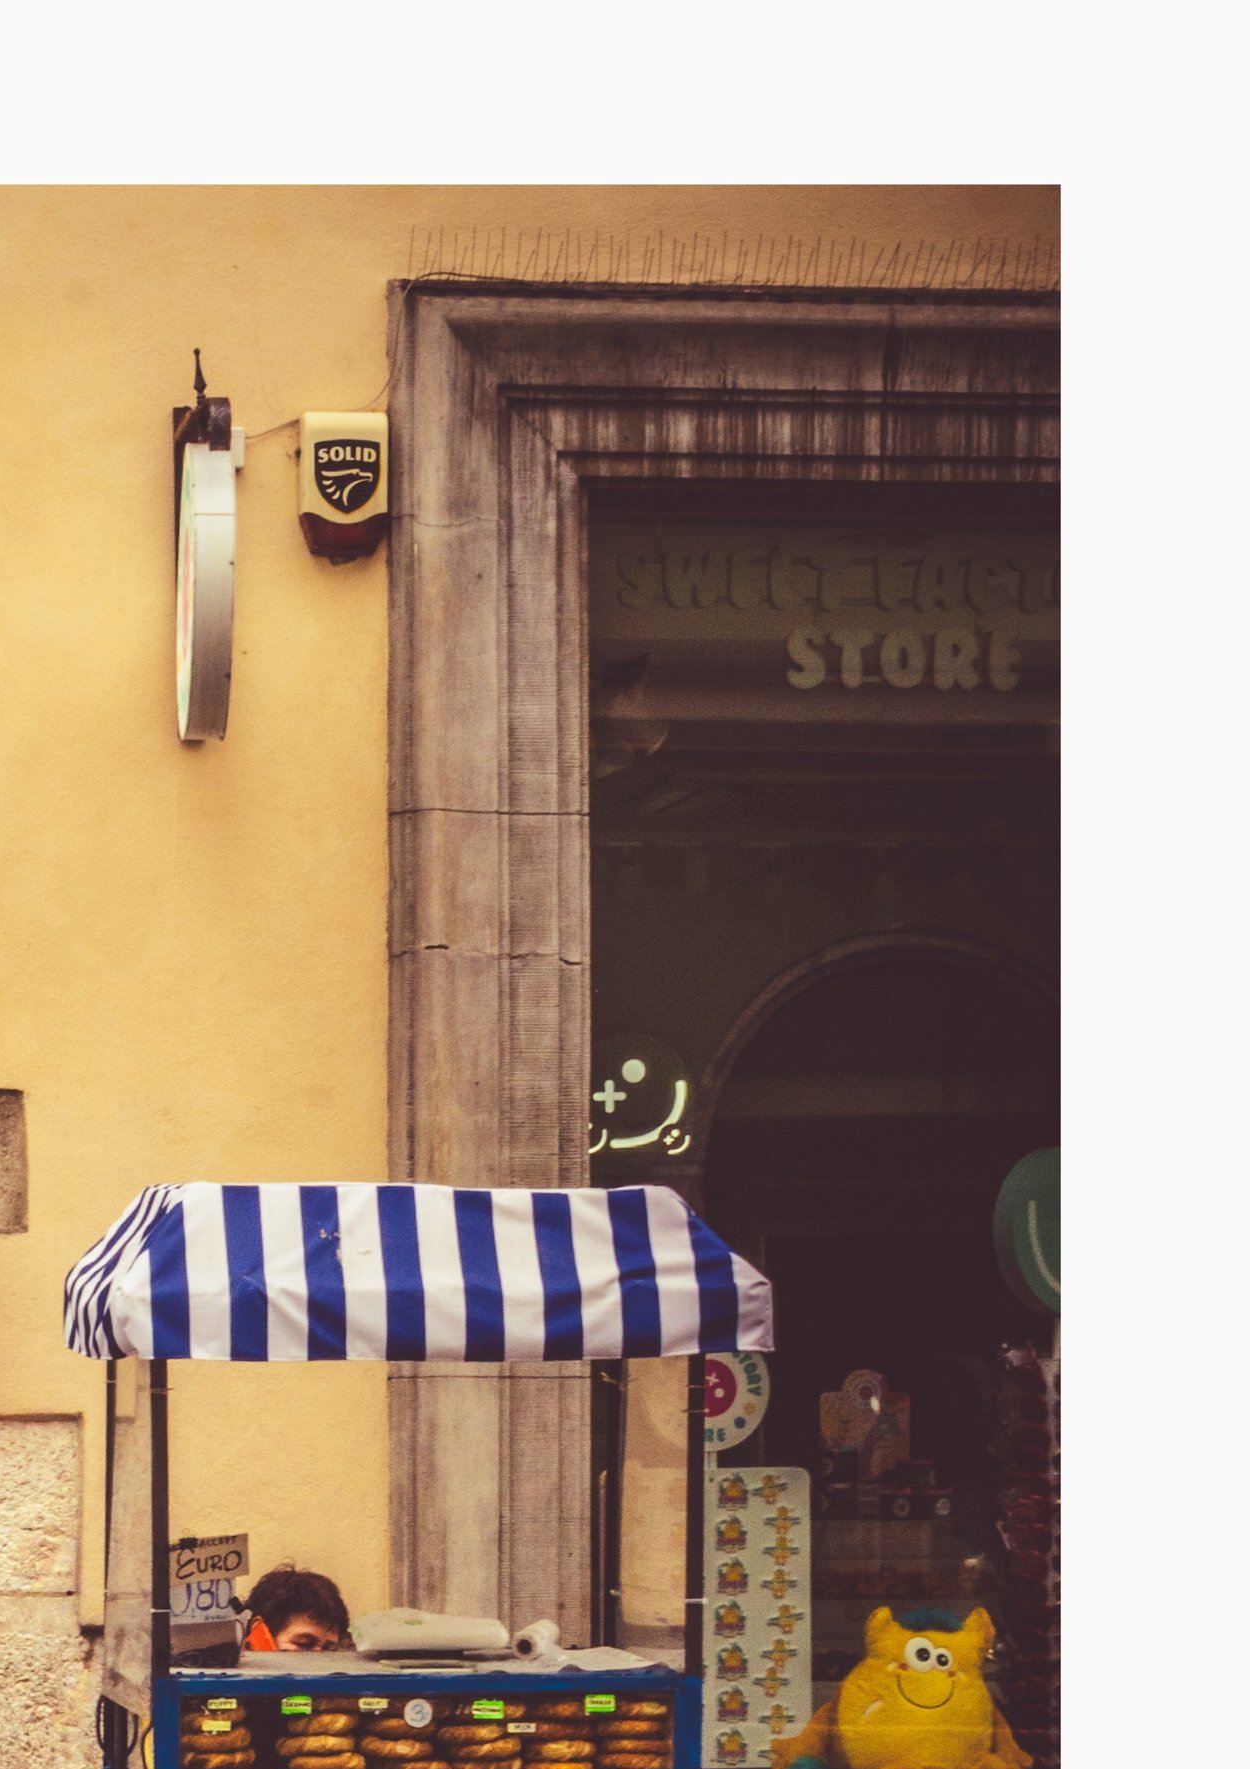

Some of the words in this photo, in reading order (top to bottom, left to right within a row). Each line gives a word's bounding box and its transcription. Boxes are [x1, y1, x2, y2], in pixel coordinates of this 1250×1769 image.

[317, 446, 377, 464] SOLID
[786, 627, 1022, 691] STORE
[734, 1352, 762, 1397] TORY
[176, 1547, 242, 1580] EURO
